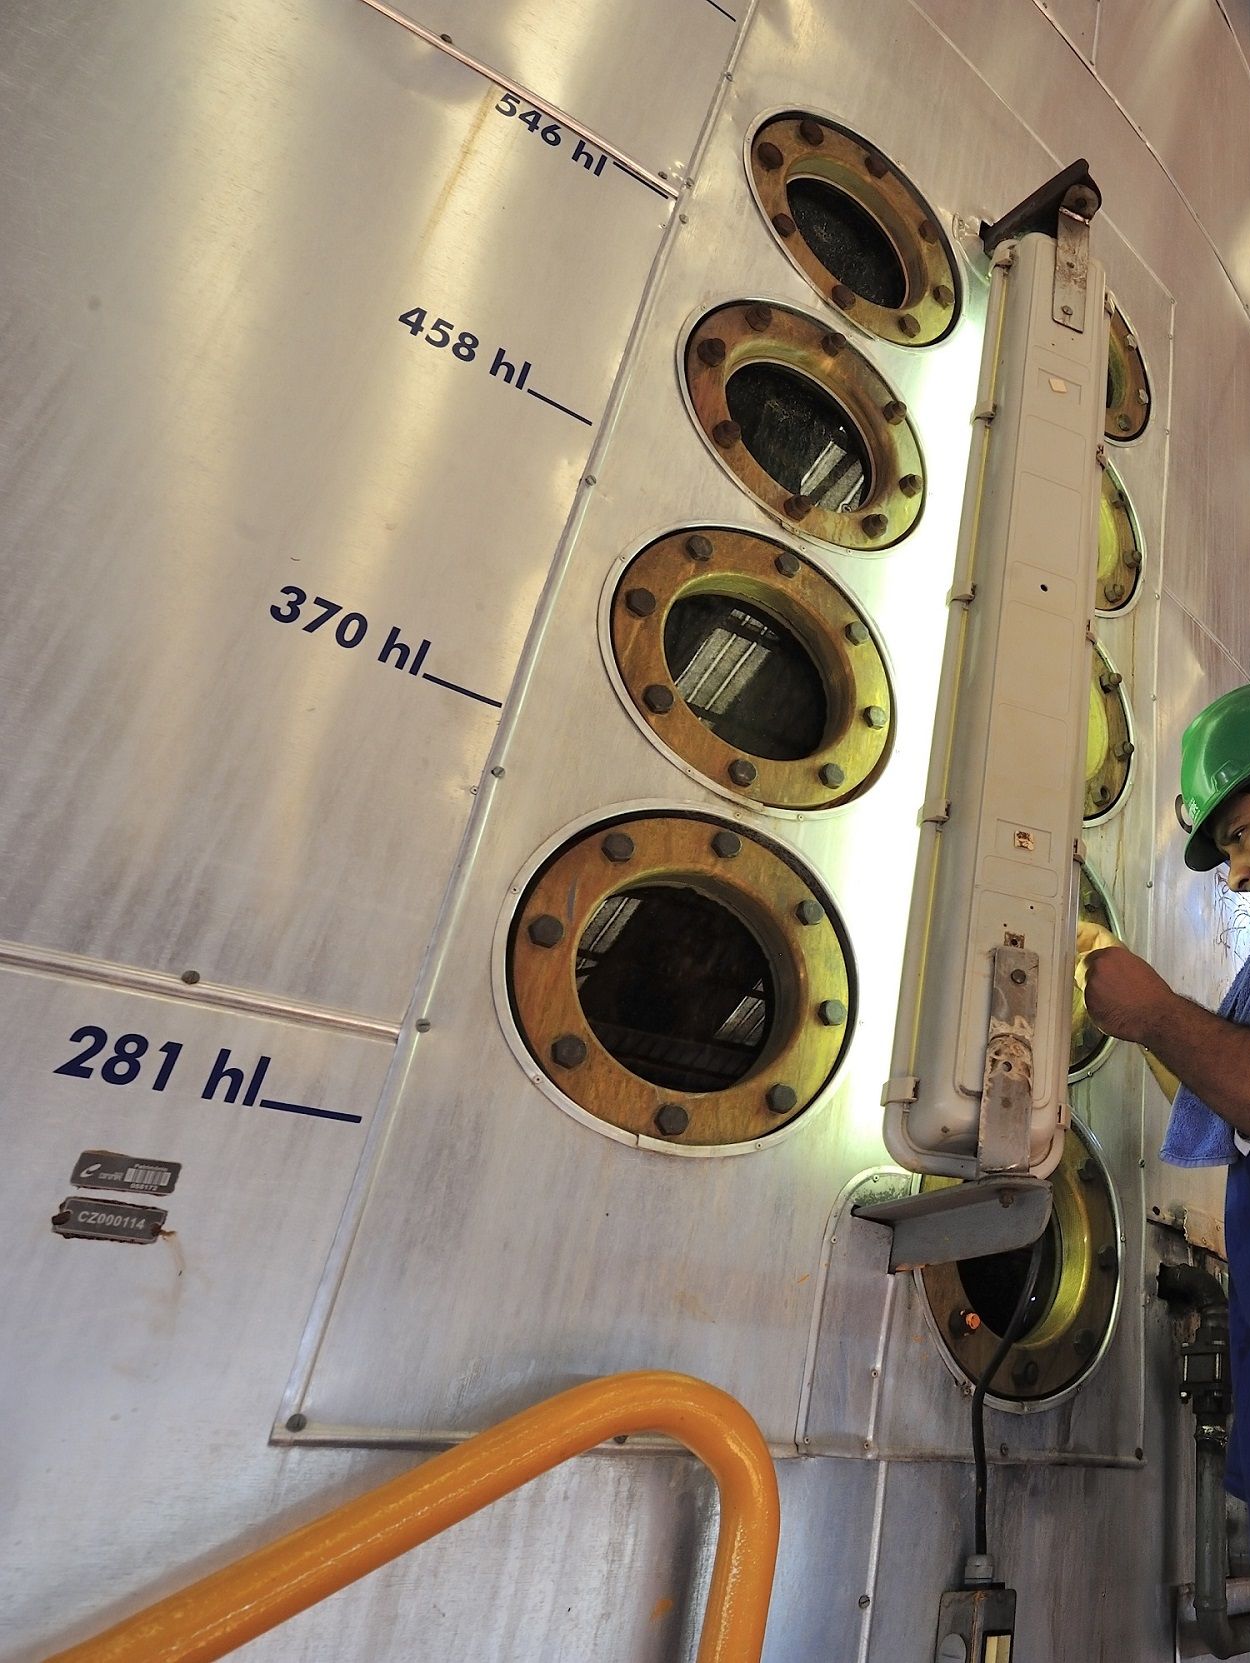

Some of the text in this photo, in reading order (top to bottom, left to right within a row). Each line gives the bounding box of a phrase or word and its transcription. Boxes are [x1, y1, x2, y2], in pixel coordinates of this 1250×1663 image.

[494, 92, 608, 177] 546 hl
[398, 306, 532, 391] 458 hl
[269, 585, 432, 677] 370 hl
[53, 1025, 271, 1107] 281 hl
[77, 1210, 146, 1230] CZ000114
